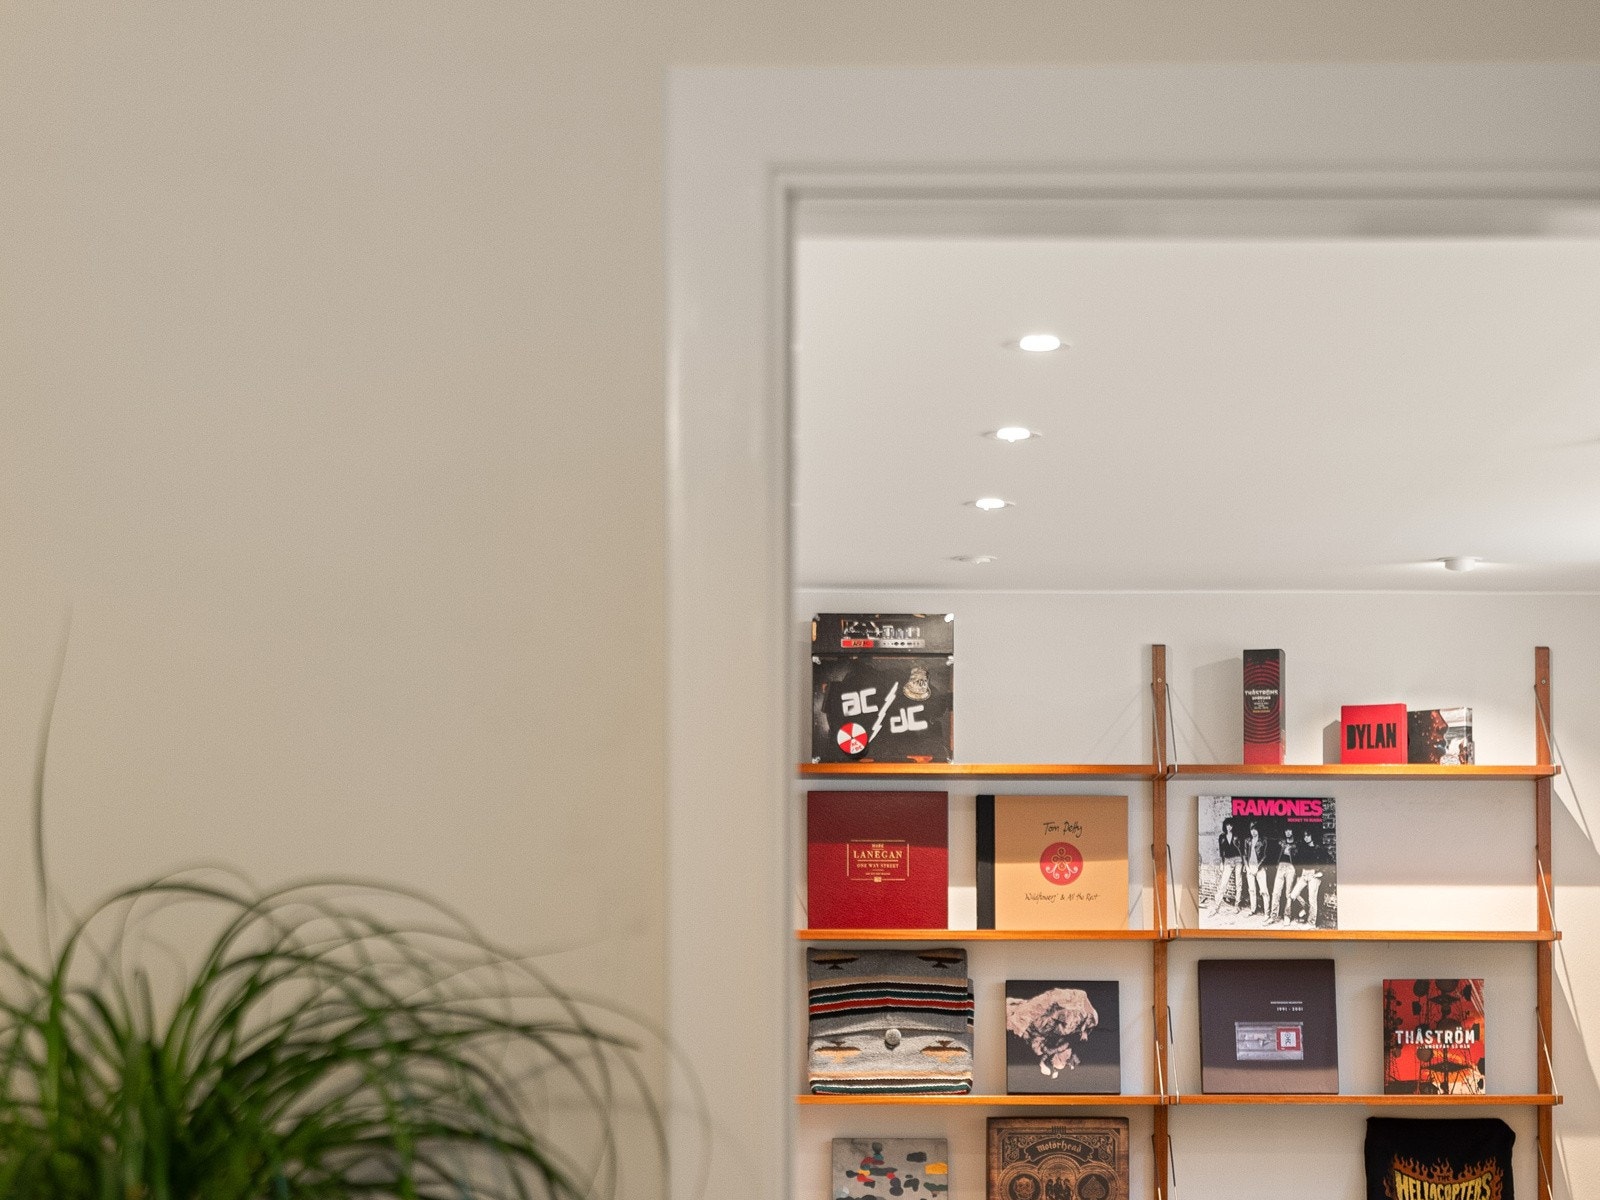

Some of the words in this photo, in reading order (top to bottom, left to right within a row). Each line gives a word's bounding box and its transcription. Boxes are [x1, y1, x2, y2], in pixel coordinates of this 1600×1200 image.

[1346, 723, 1396, 750] DYLAN
[1232, 799, 1322, 816] RAMONES
[1043, 821, 1060, 836] Tom
[853, 850, 902, 858] LANEGAN
[1395, 1026, 1475, 1044] THÅSTRÖM
